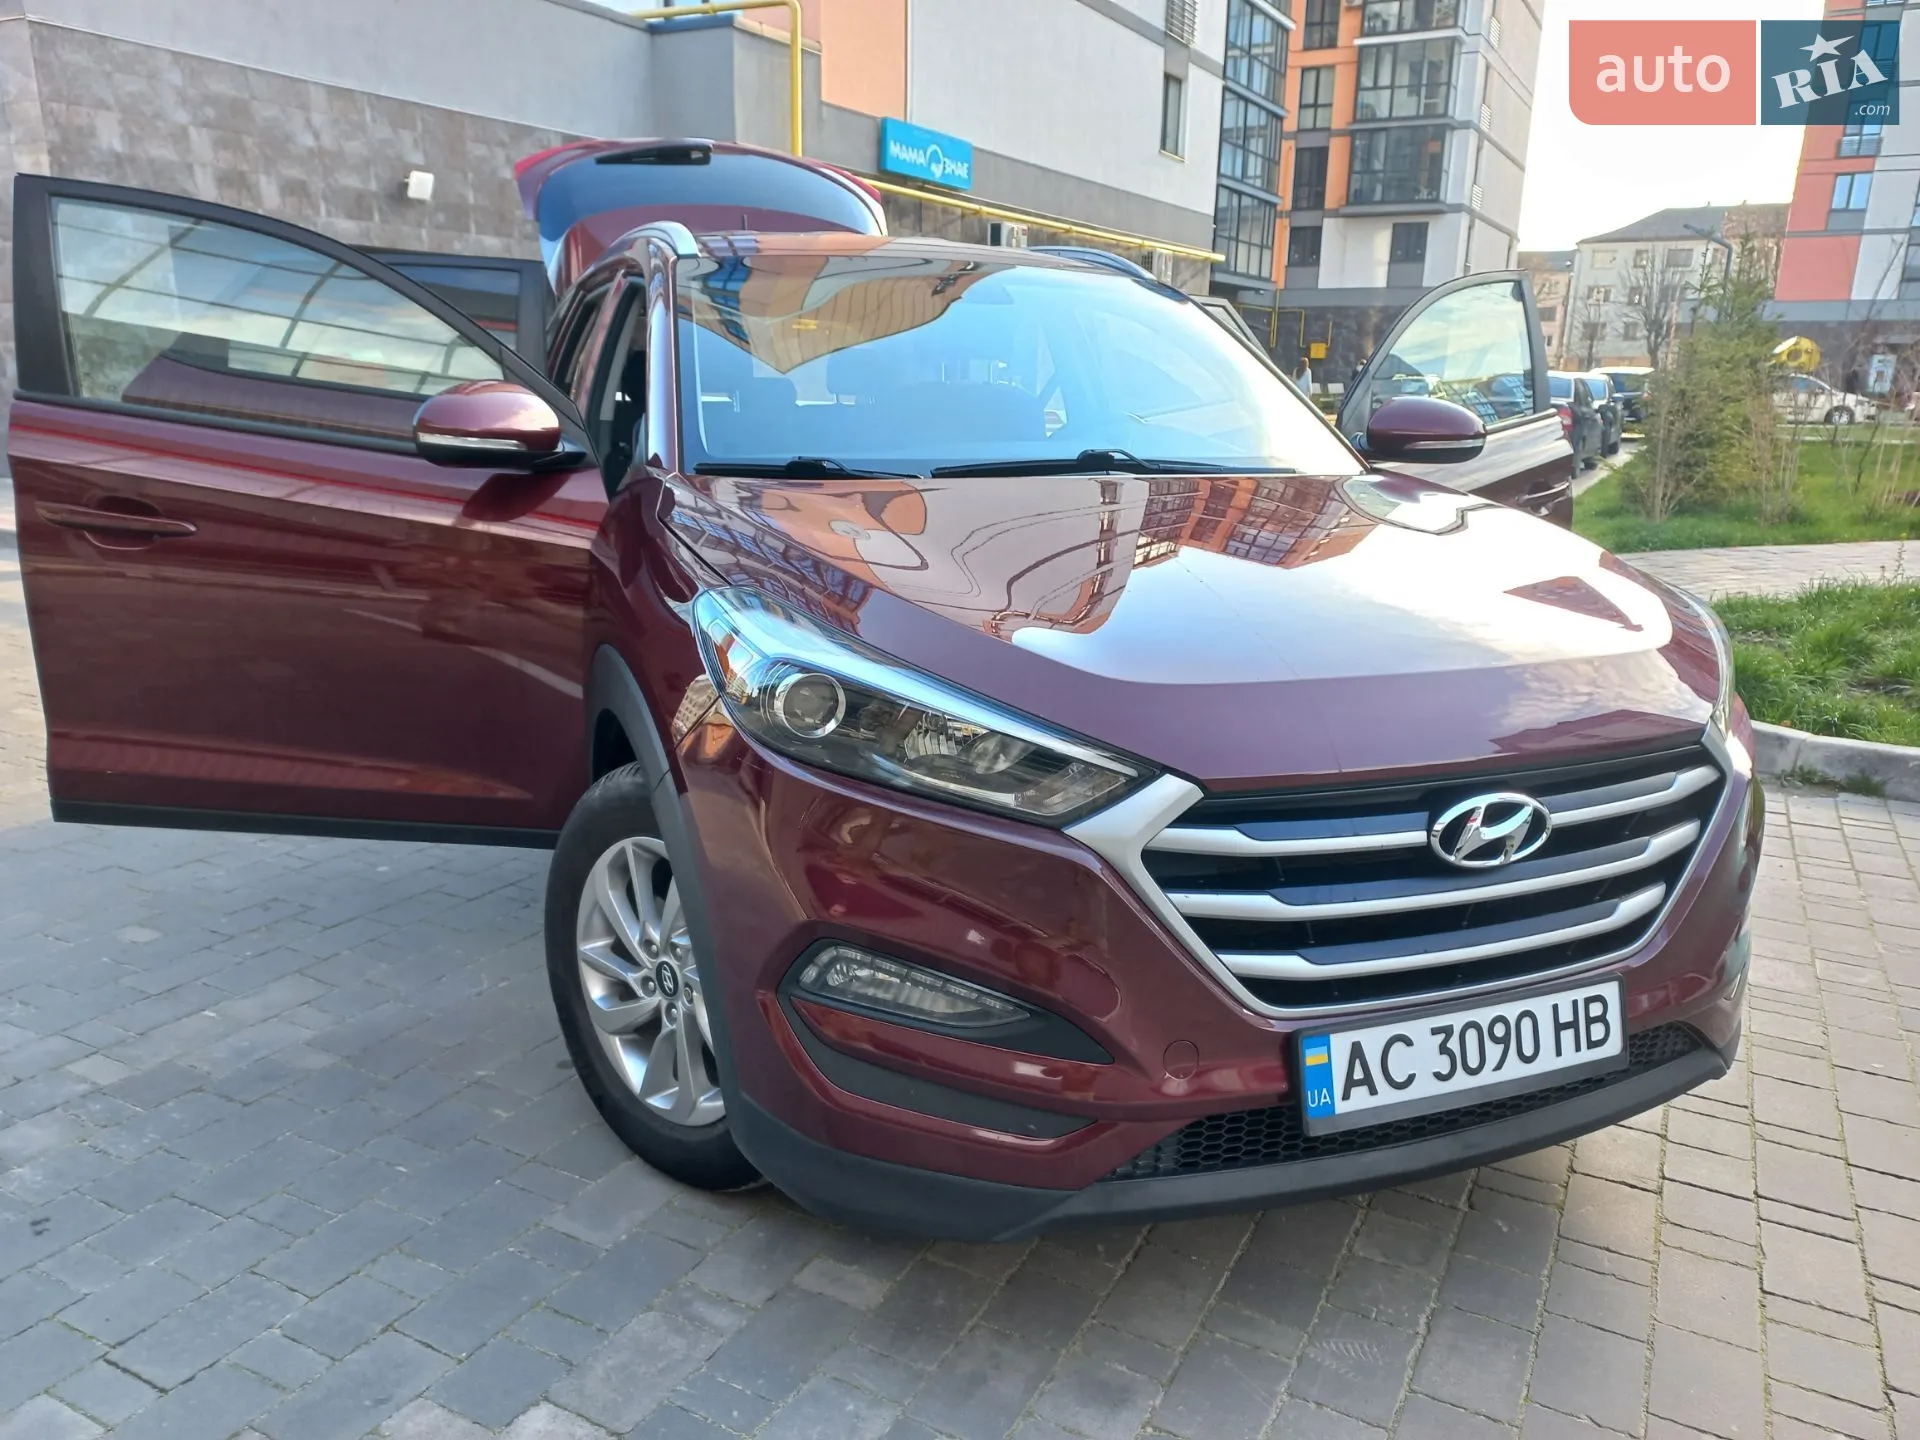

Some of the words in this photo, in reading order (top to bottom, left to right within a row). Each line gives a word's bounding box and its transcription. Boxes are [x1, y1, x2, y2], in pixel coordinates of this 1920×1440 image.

[1341, 1033, 1417, 1102] AC
[1430, 1009, 1541, 1082] 3090
[1552, 993, 1611, 1058] HB
[1307, 1087, 1332, 1108] UA
